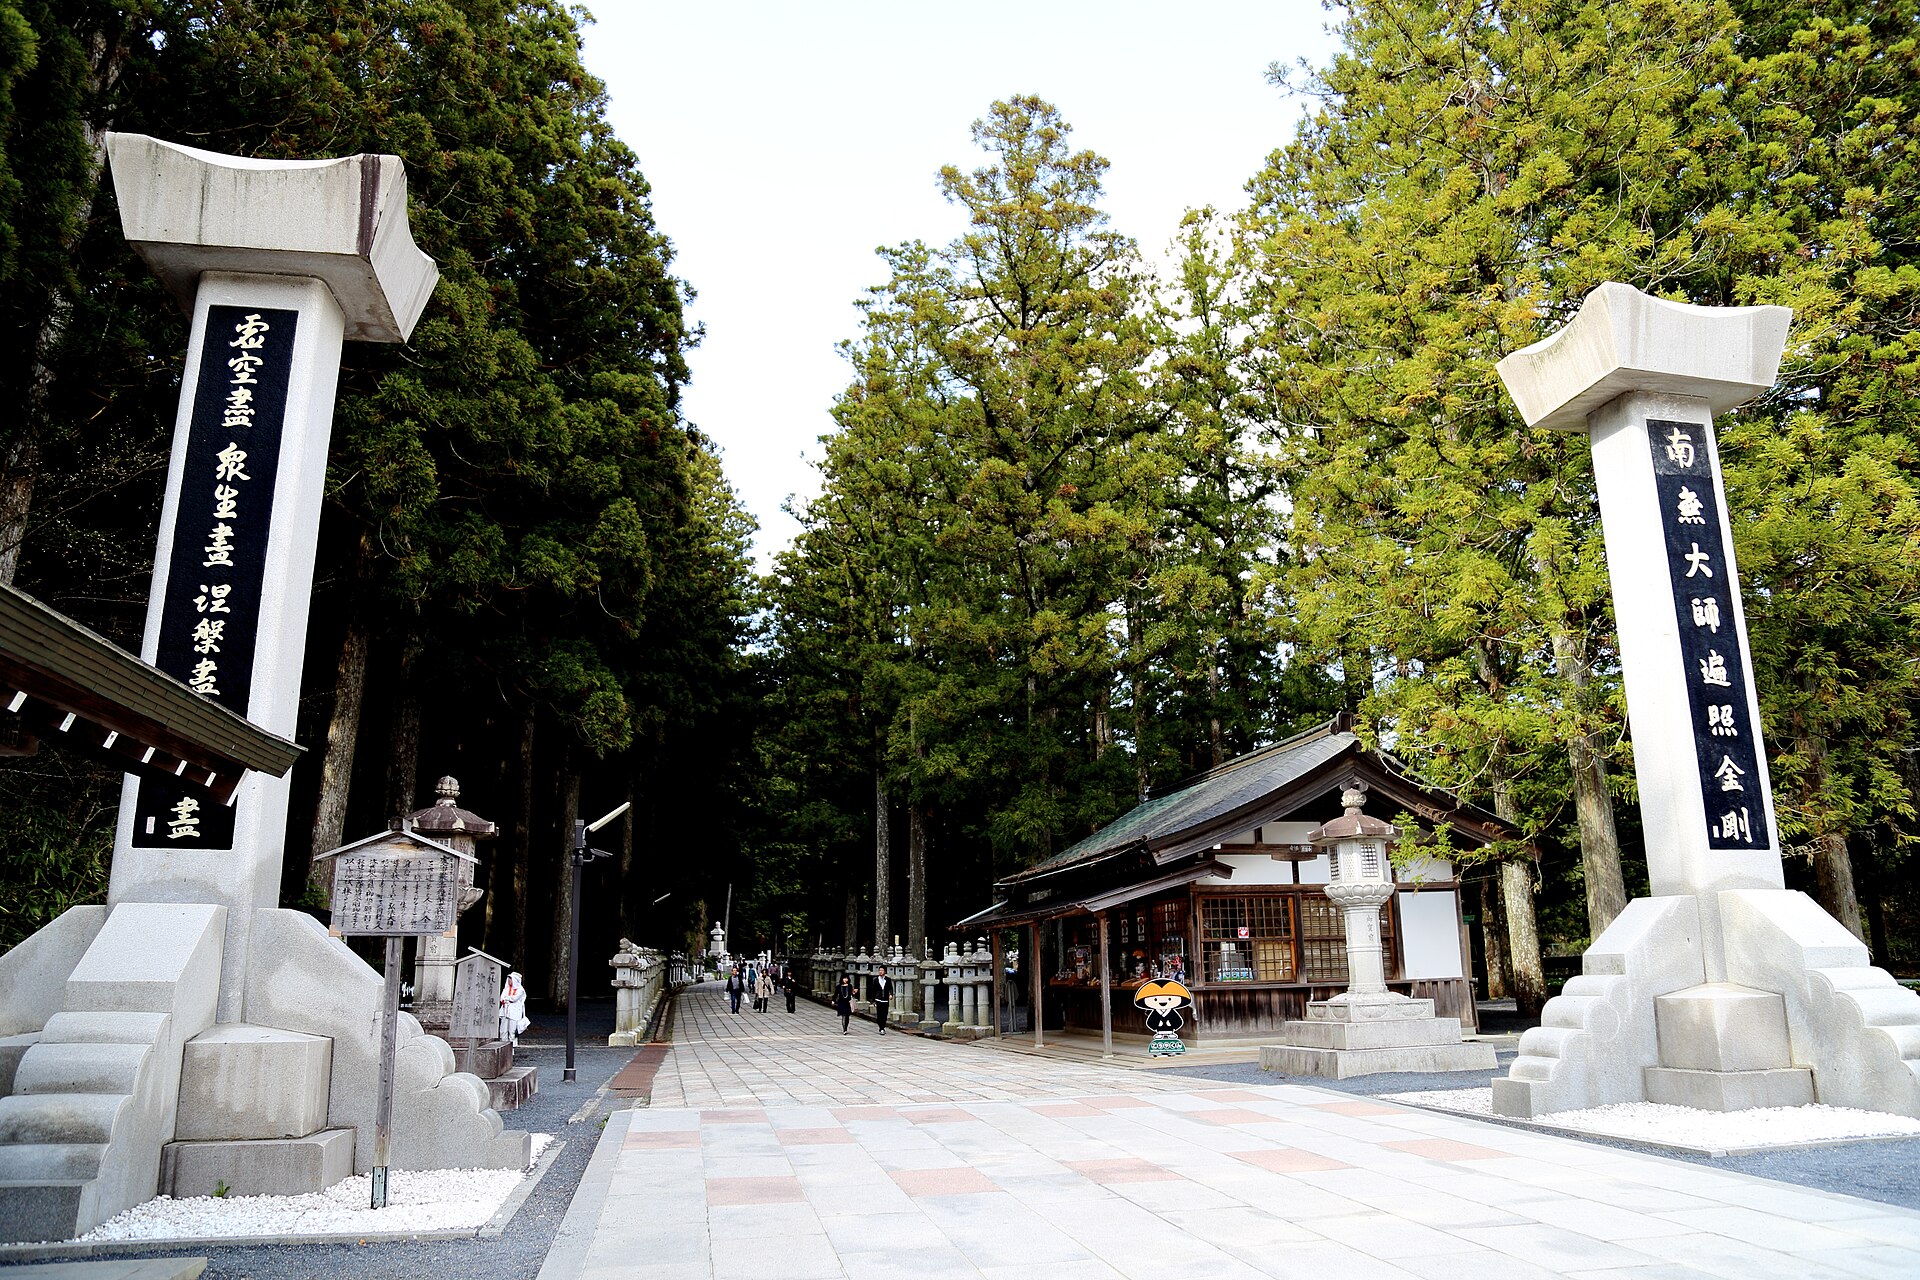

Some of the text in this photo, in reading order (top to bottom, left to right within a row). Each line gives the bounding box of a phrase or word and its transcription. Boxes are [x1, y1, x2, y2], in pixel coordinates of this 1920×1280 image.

[1666, 430, 1753, 843] 南無大師遍照金剛
